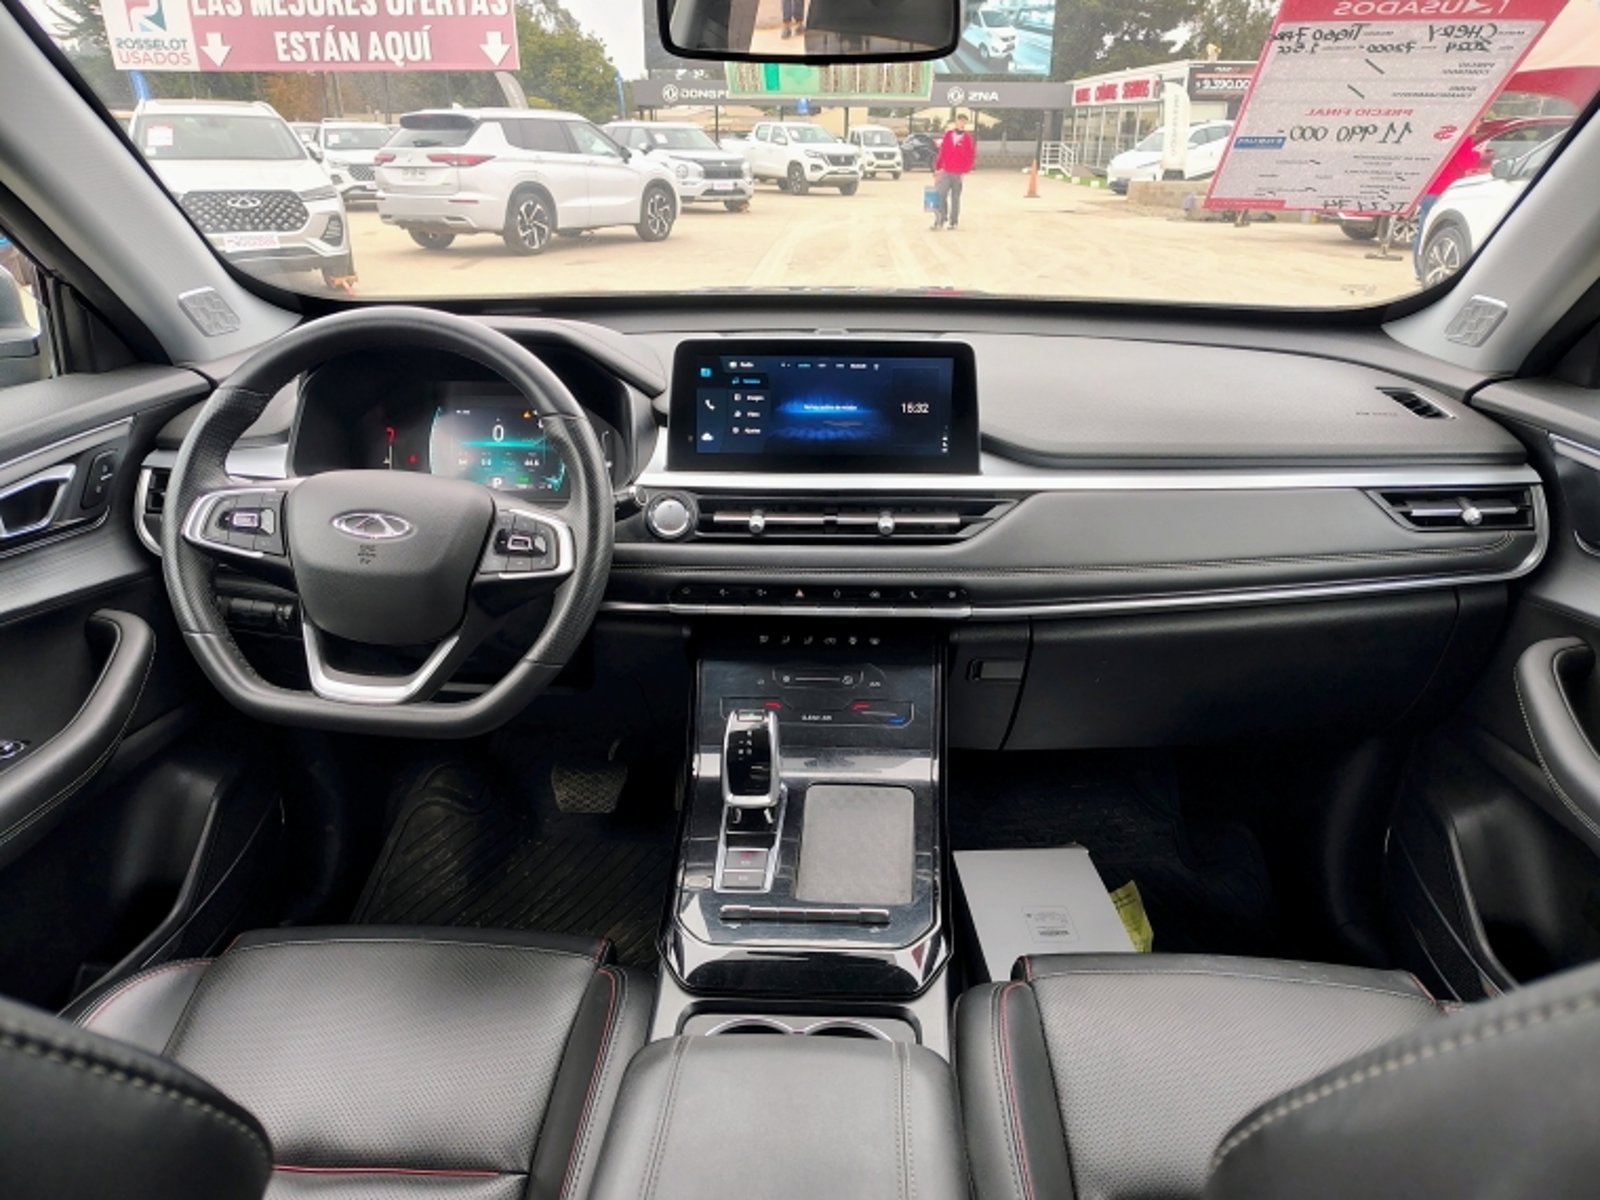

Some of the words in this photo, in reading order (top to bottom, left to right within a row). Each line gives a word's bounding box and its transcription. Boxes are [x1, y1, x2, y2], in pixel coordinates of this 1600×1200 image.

[115, 37, 188, 51] ROSSELOT
[274, 25, 361, 62] ESTÁN
[367, 24, 433, 67] AQUÍ
[118, 50, 192, 66] USADOS
[968, 91, 1000, 102] ZNA
[491, 424, 505, 443] 0
